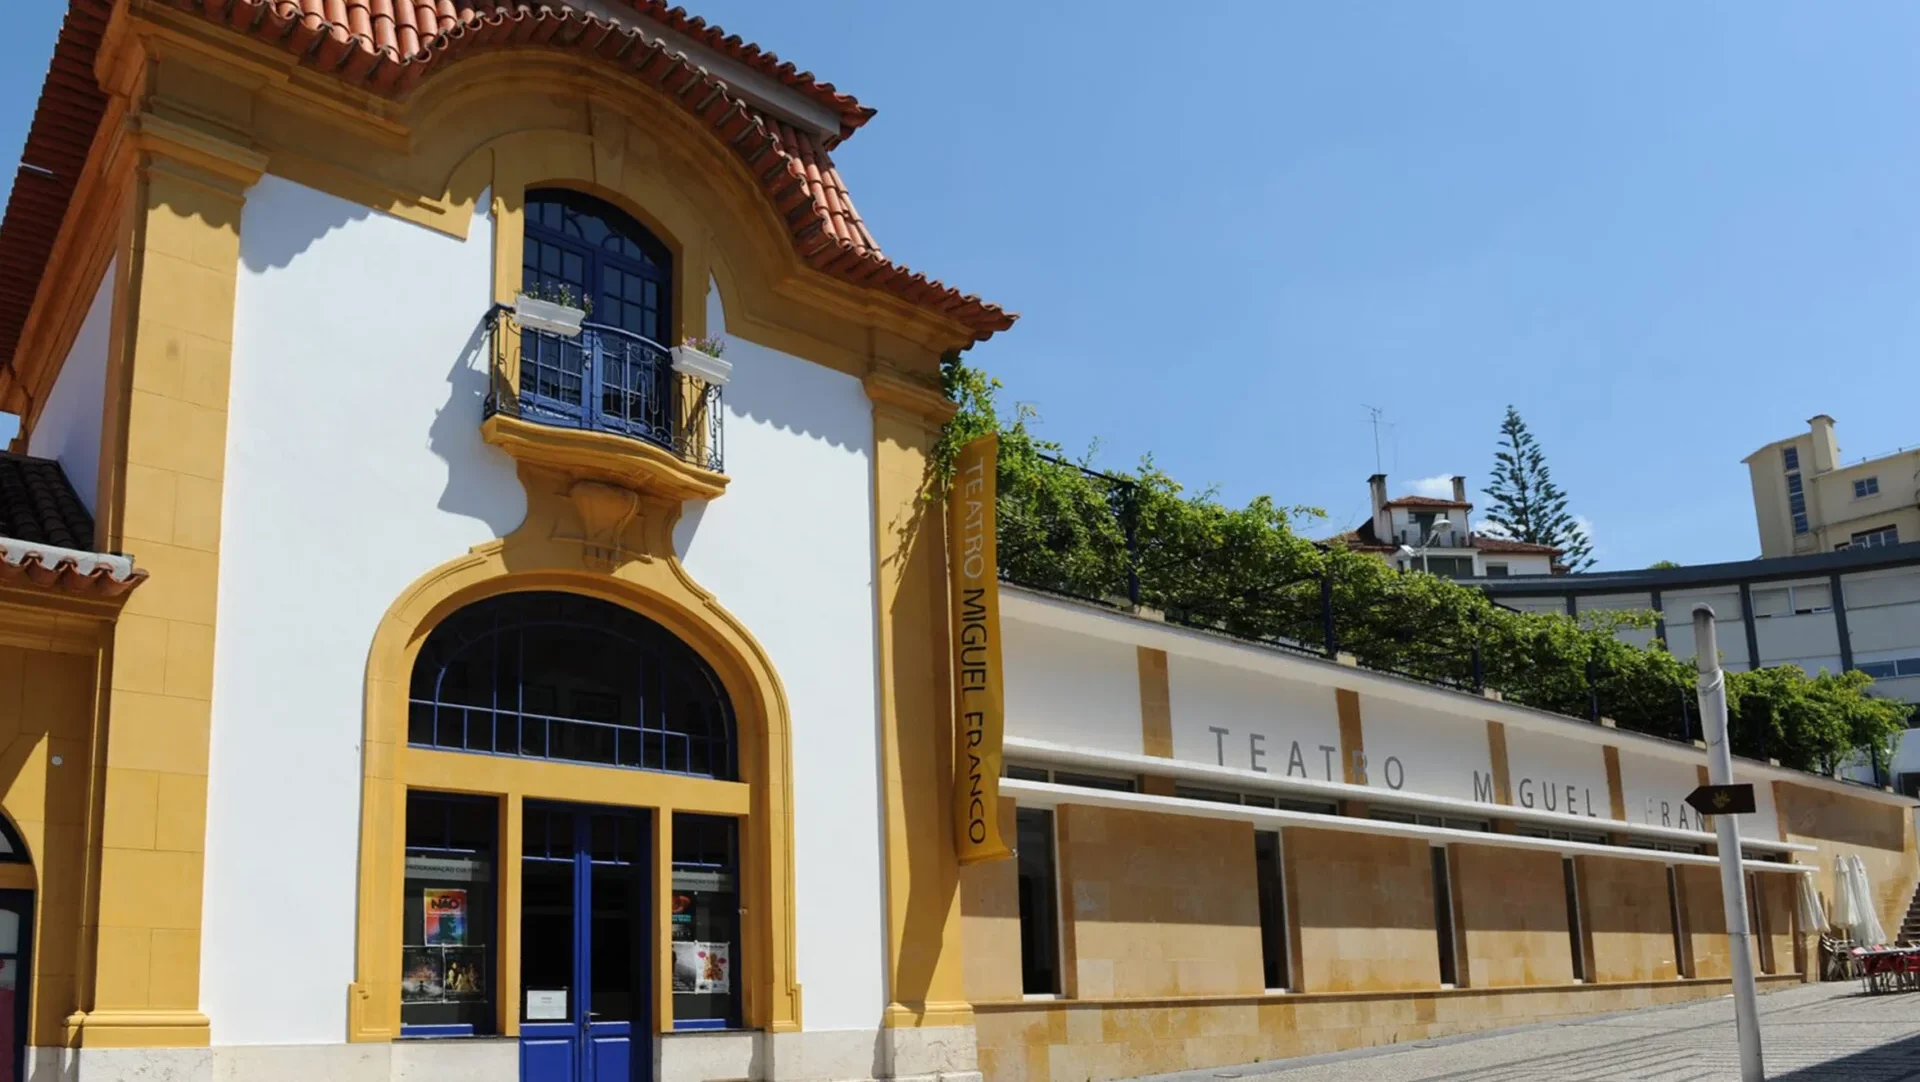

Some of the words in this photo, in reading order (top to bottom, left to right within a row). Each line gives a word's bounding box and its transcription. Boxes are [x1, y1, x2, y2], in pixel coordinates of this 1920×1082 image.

[964, 456, 985, 578] TEATRO
[961, 588, 987, 703] MIGUEL
[964, 712, 986, 844] FRANCO
[1208, 726, 1405, 791] TEATRO
[1473, 770, 1597, 818] MIGUEL
[1645, 797, 1715, 832] FRAN
[431, 895, 460, 909] NÃO
